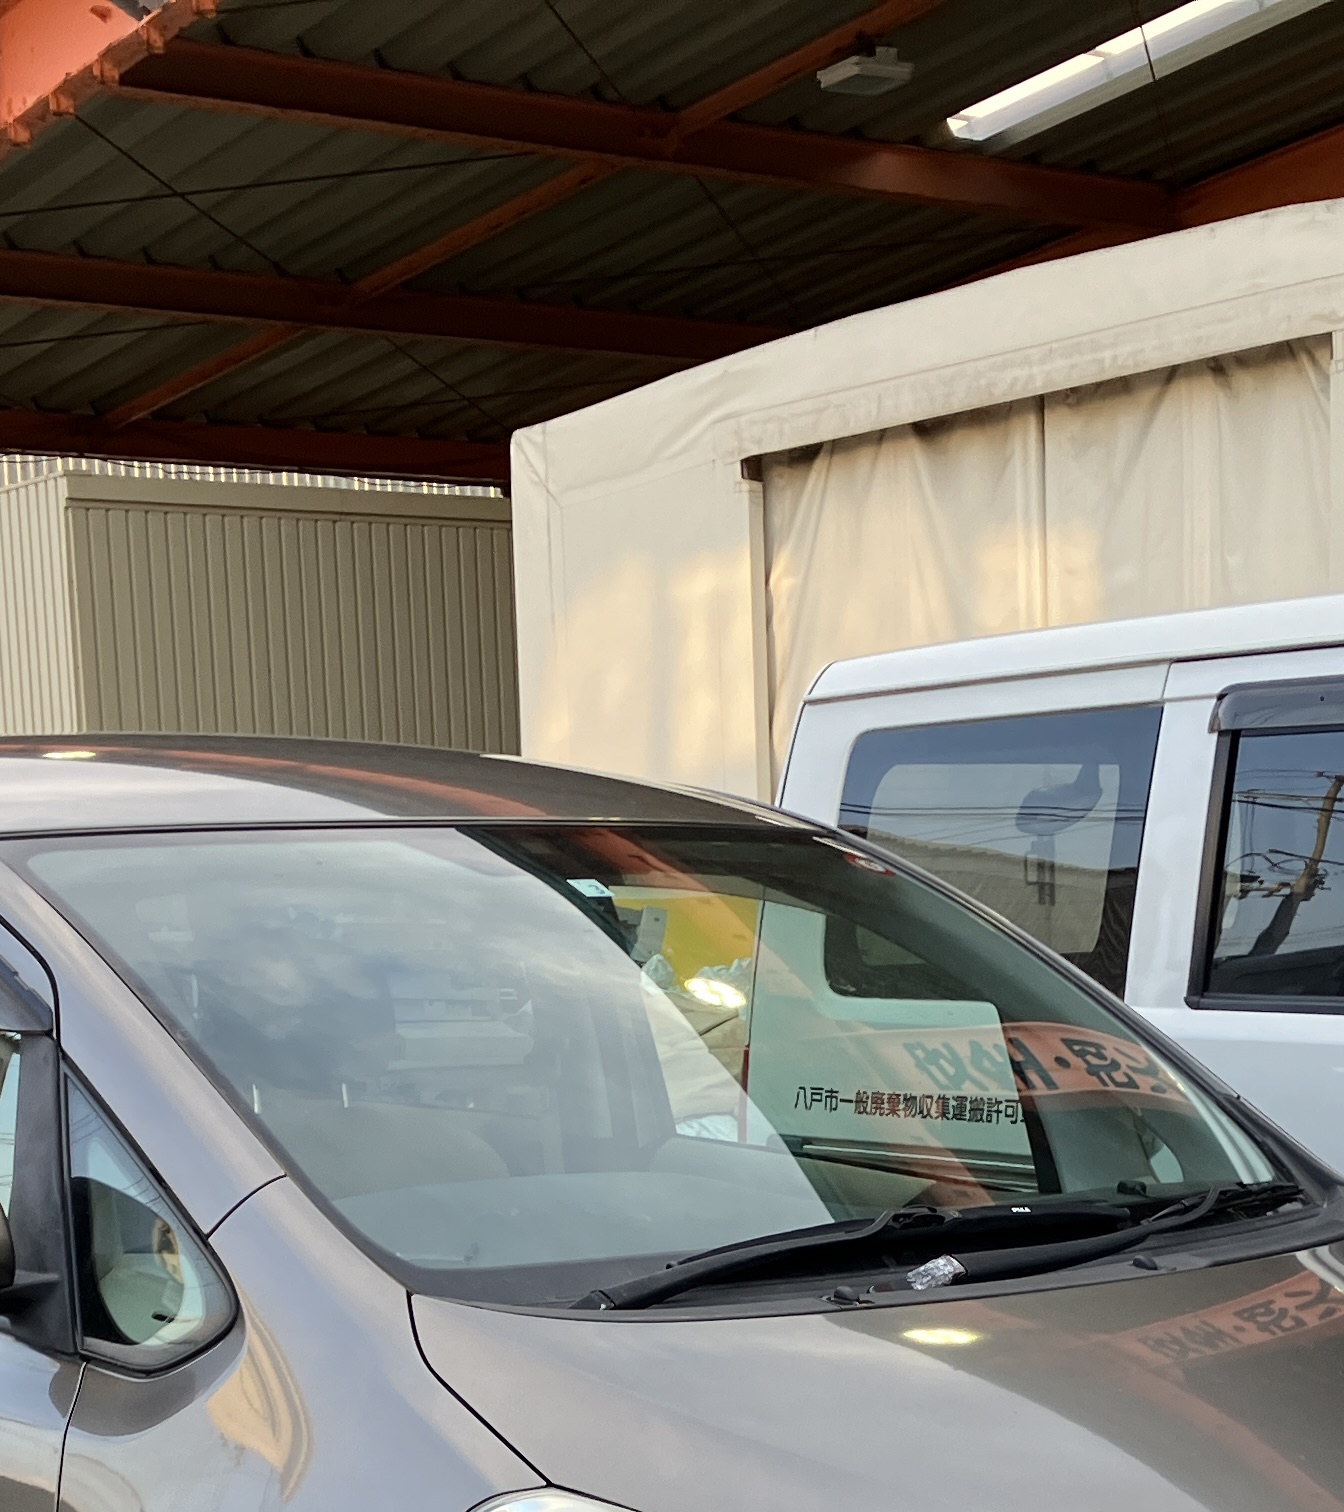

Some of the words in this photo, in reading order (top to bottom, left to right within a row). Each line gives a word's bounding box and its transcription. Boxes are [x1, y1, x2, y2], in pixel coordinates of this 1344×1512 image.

[794, 1086, 1025, 1125] 八戸市一般廃棄物収集運搬許可
